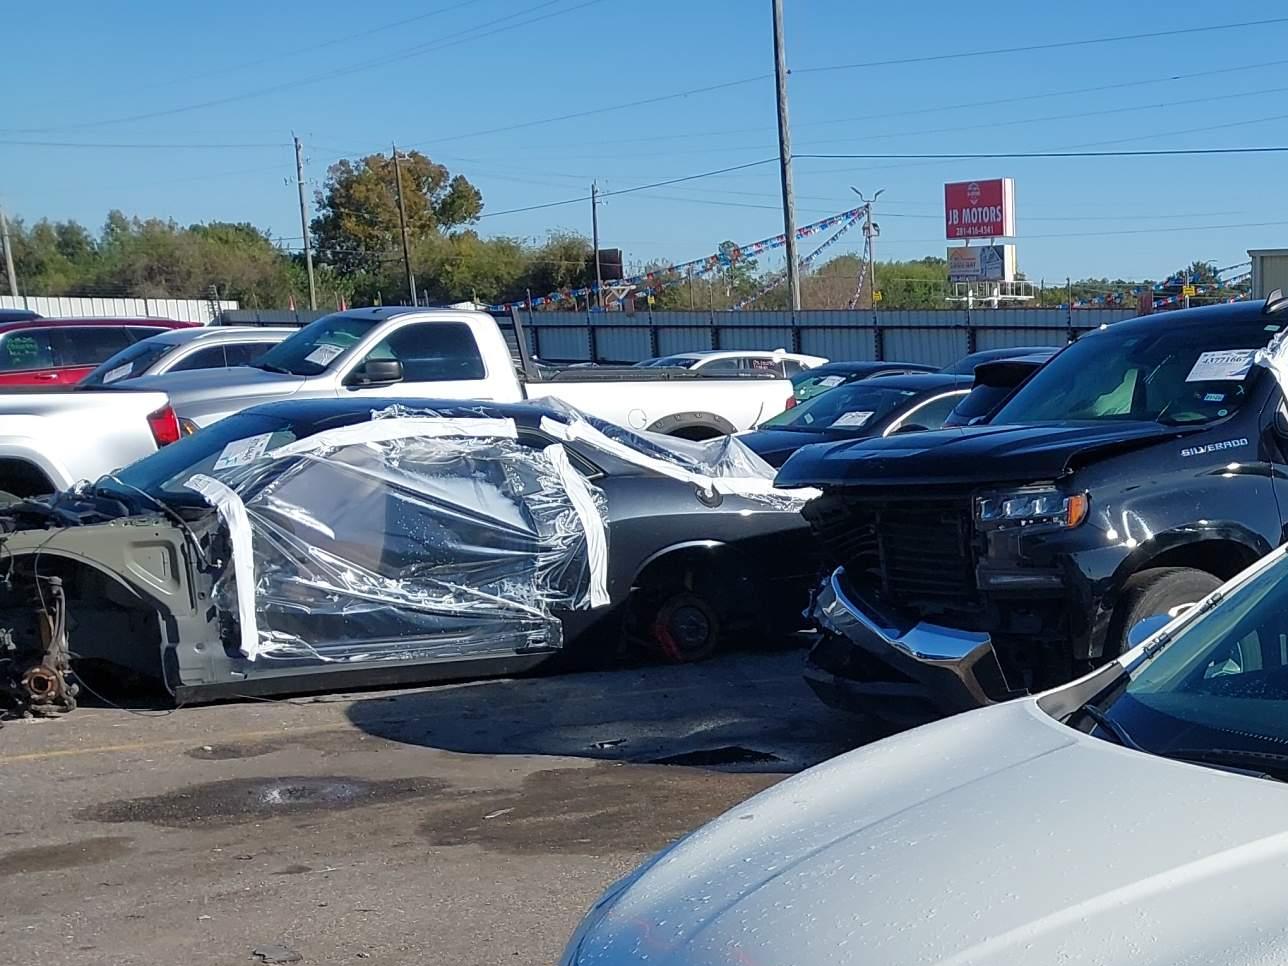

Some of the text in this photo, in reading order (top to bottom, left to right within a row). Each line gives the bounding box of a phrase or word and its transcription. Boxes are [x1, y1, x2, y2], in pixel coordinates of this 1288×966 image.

[948, 206, 1001, 224] JB MOTORS
[1181, 438, 1248, 456] SILVERADO
